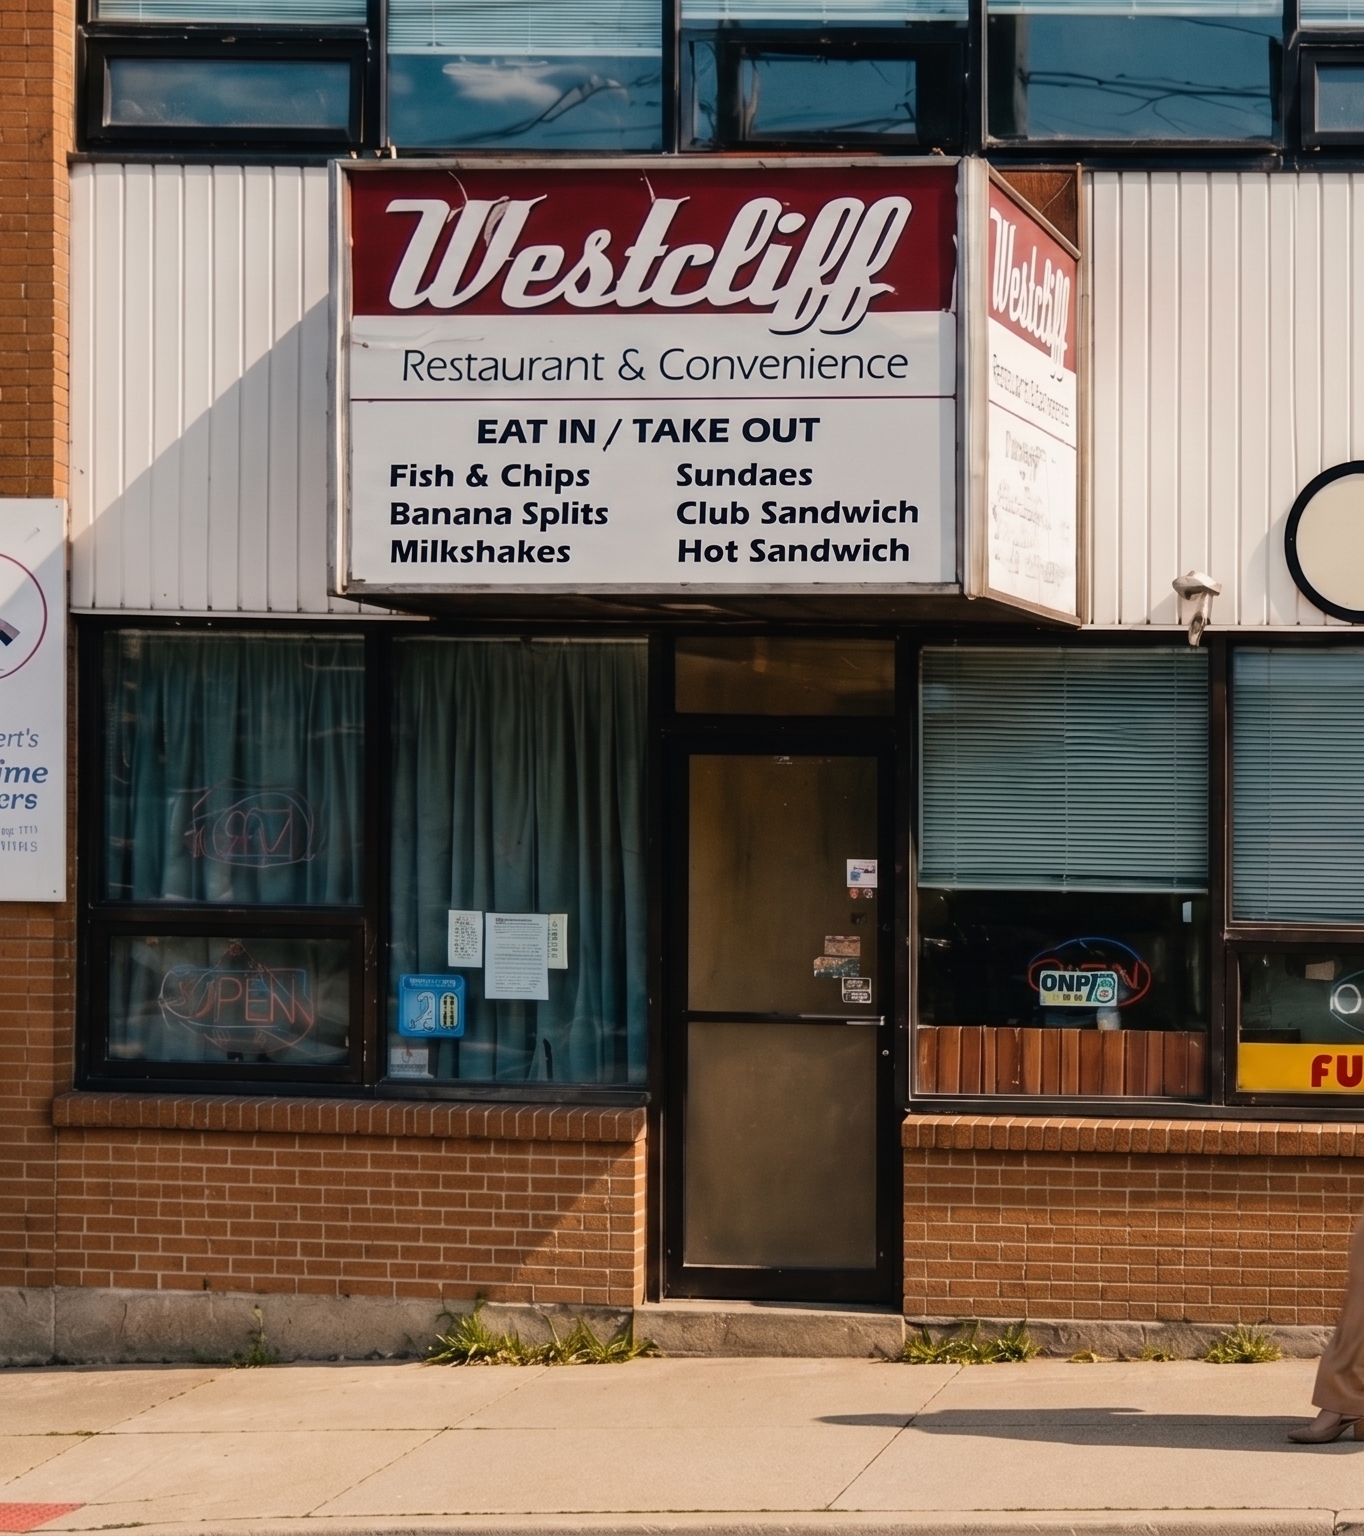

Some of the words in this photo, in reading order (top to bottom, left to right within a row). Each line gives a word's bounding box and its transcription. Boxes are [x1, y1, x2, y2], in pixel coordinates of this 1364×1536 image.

[385, 195, 913, 335] Westcliff
[990, 206, 1071, 382] Westcliff
[403, 349, 605, 382] Restaurant
[618, 349, 646, 381] &
[659, 347, 909, 381] Convenience
[477, 419, 549, 444] EAT
[558, 418, 596, 444] IN
[602, 418, 623, 453] /
[632, 418, 730, 443] TAKE
[742, 417, 821, 443] OUT
[390, 463, 454, 488] Fish
[465, 463, 489, 488] &
[500, 463, 590, 493] Chips
[676, 462, 813, 487] Sundaes
[390, 501, 512, 526] Banana
[522, 501, 609, 531] Splits
[676, 500, 750, 525] Club
[760, 499, 919, 525] Sandwich
[390, 539, 571, 564] Milkshakes
[678, 539, 739, 563] Hot
[749, 537, 910, 563] Sandwich
